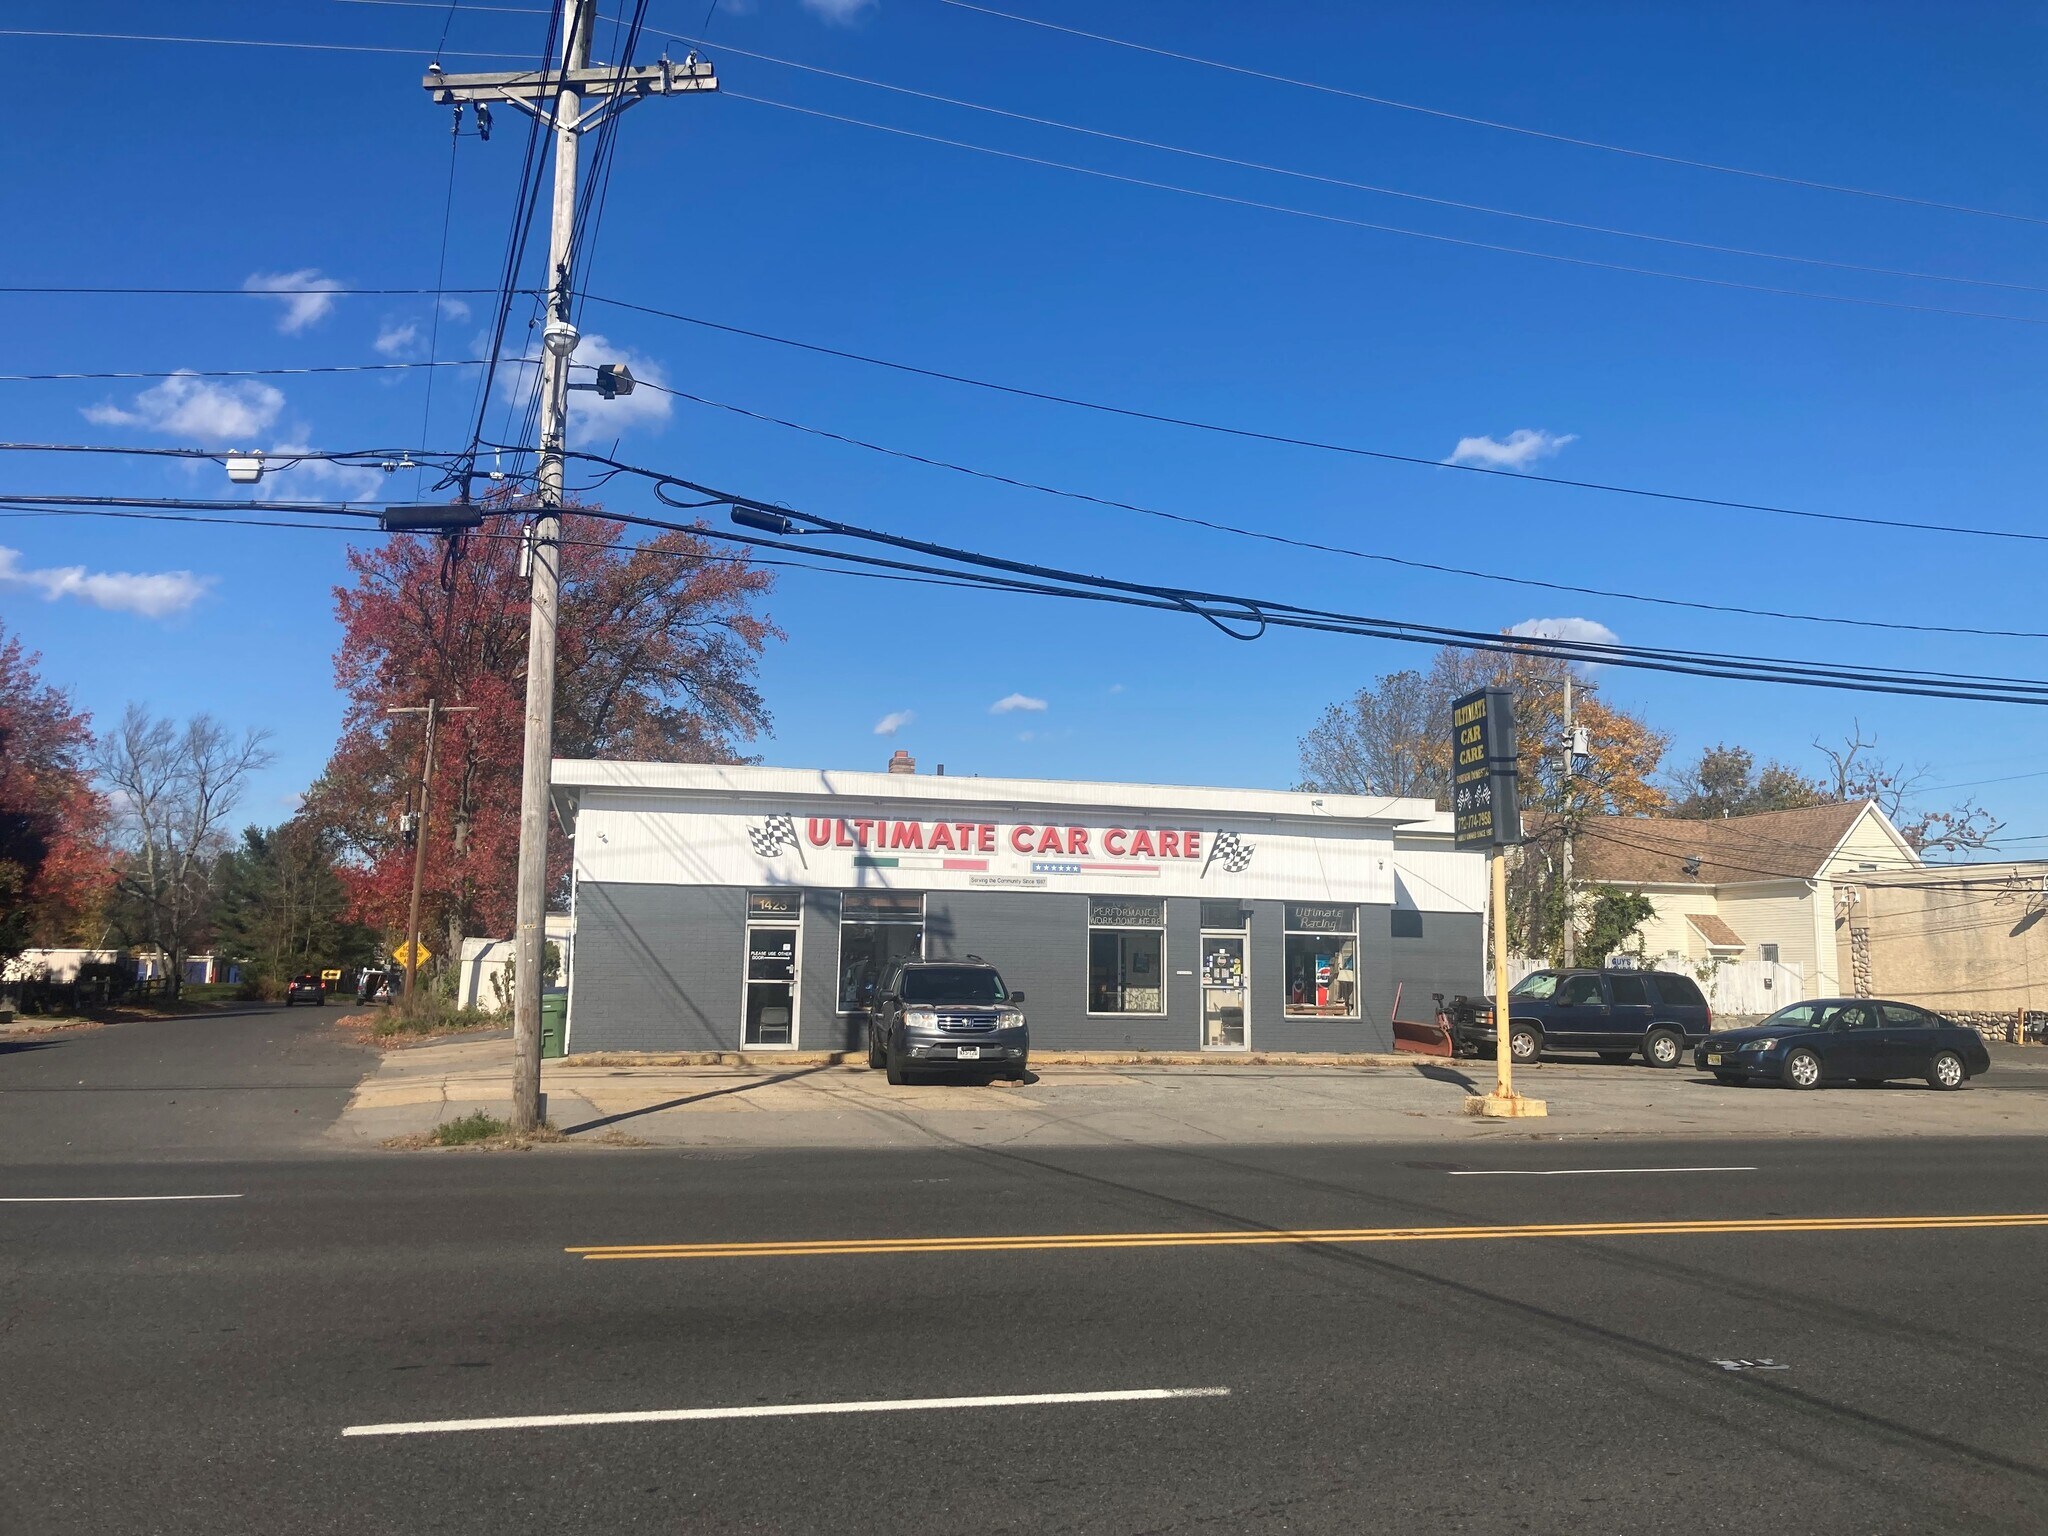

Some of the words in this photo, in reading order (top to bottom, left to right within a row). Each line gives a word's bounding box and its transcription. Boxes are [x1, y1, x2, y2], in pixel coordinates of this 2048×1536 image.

[1454, 698, 1487, 728] ULTIMATE
[1460, 725, 1482, 746] CAR
[1459, 744, 1484, 766] CARE
[808, 818, 996, 852] ULTIMATE
[1011, 825, 1090, 855] CAR
[1103, 827, 1201, 859] CARE
[970, 877, 988, 885] Serving
[997, 877, 1022, 885] Community
[760, 899, 788, 911] 1423
[1093, 906, 1159, 917] PERFORMANCE
[1295, 907, 1344, 918] Ultimate
[1300, 917, 1337, 932] Racing
